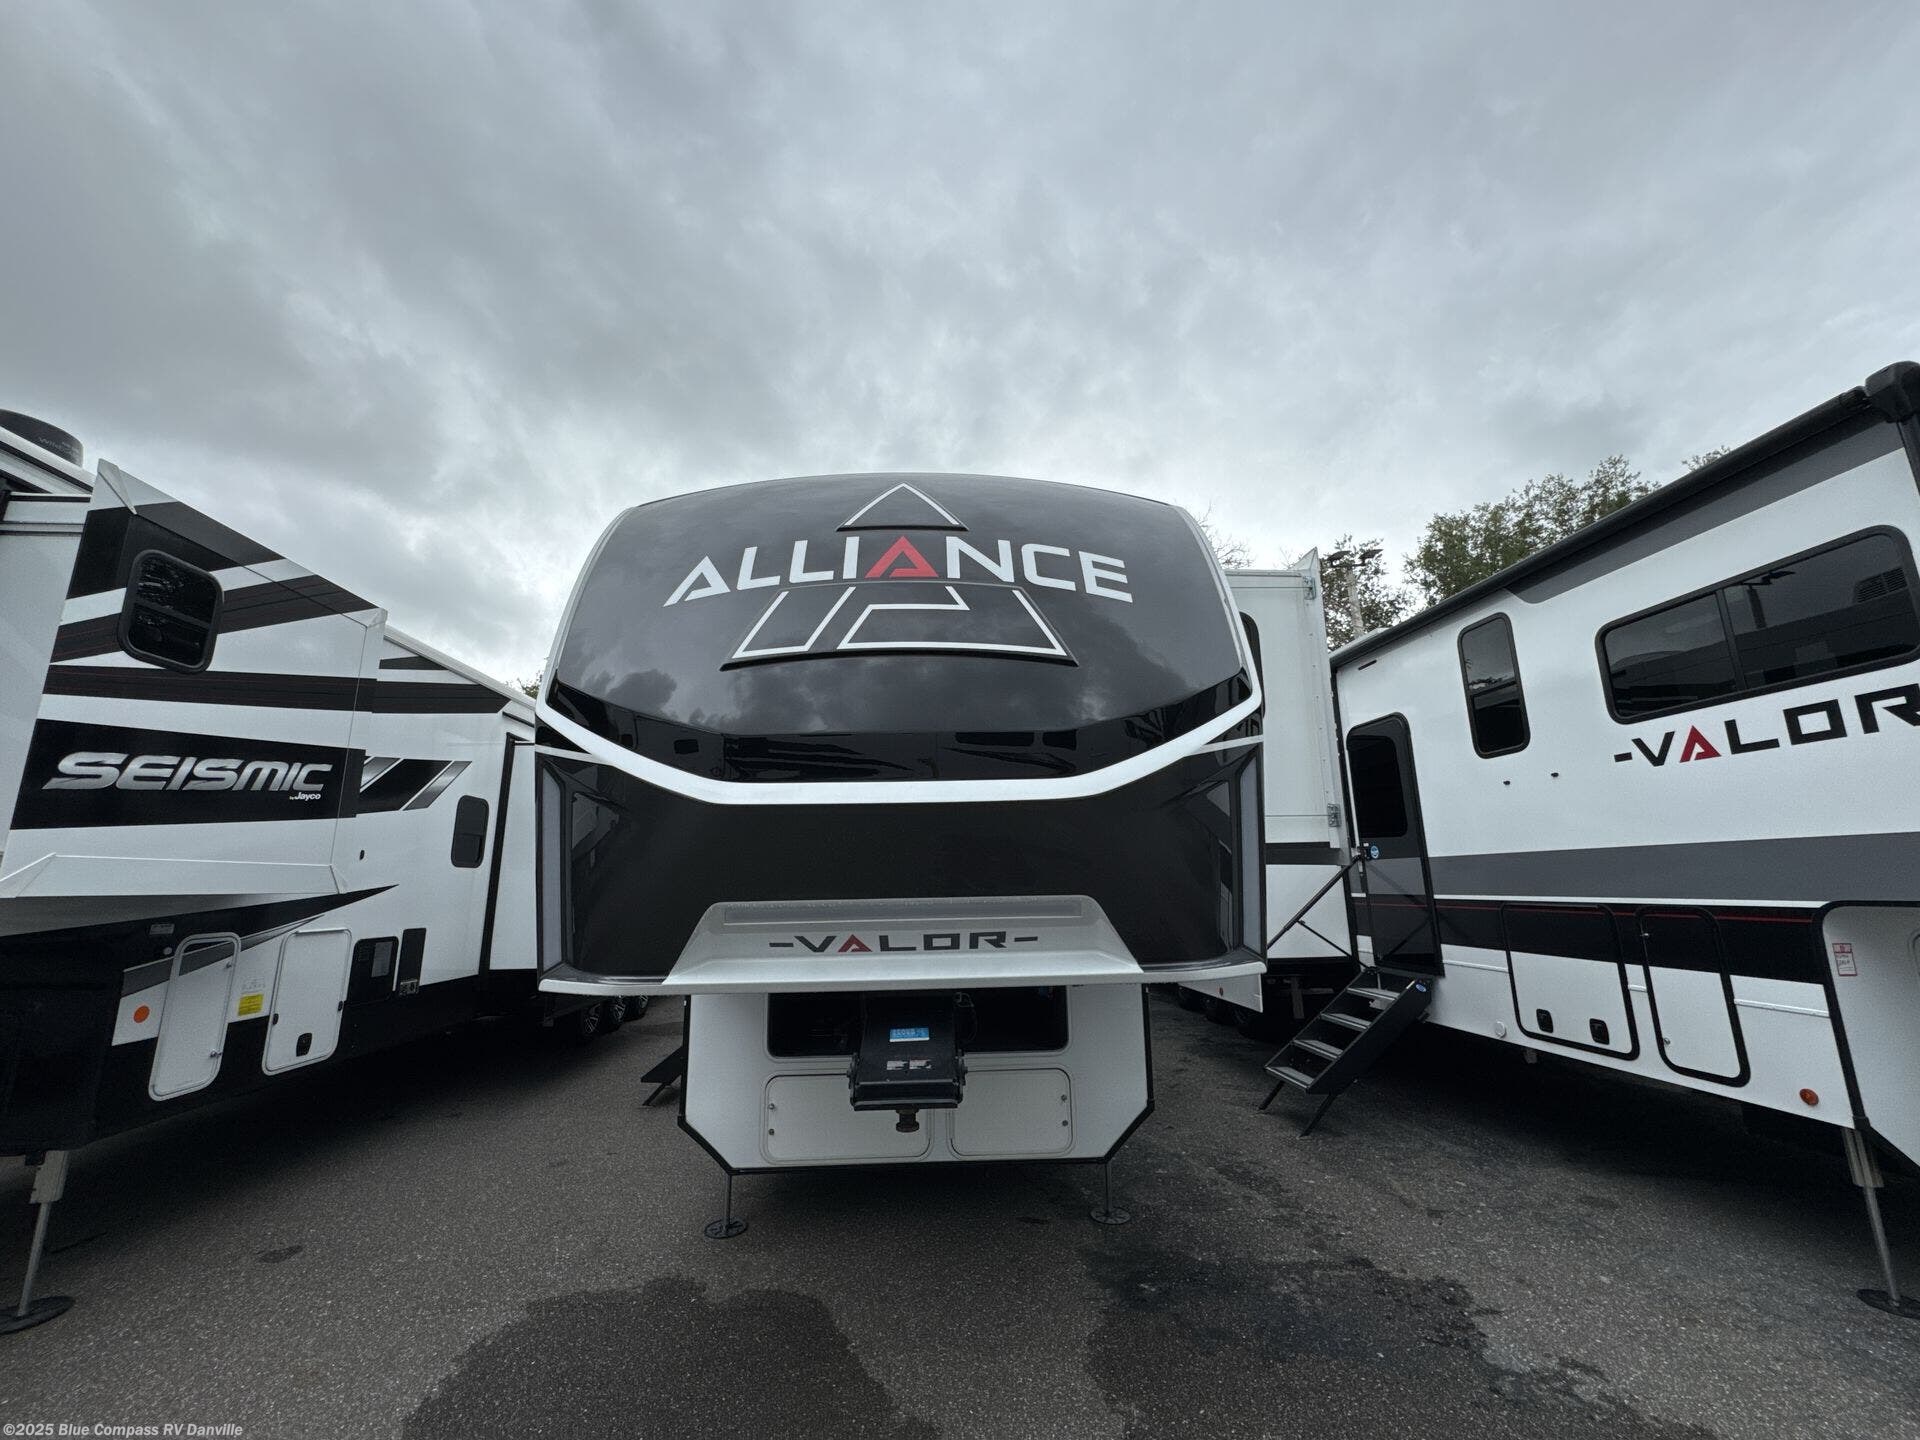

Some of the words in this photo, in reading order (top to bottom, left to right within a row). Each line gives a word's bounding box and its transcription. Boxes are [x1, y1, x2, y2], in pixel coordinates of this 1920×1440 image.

[663, 535, 1133, 607] ALLIANCE
[42, 752, 332, 791] SEISMIC
[295, 792, 322, 802] Jayco
